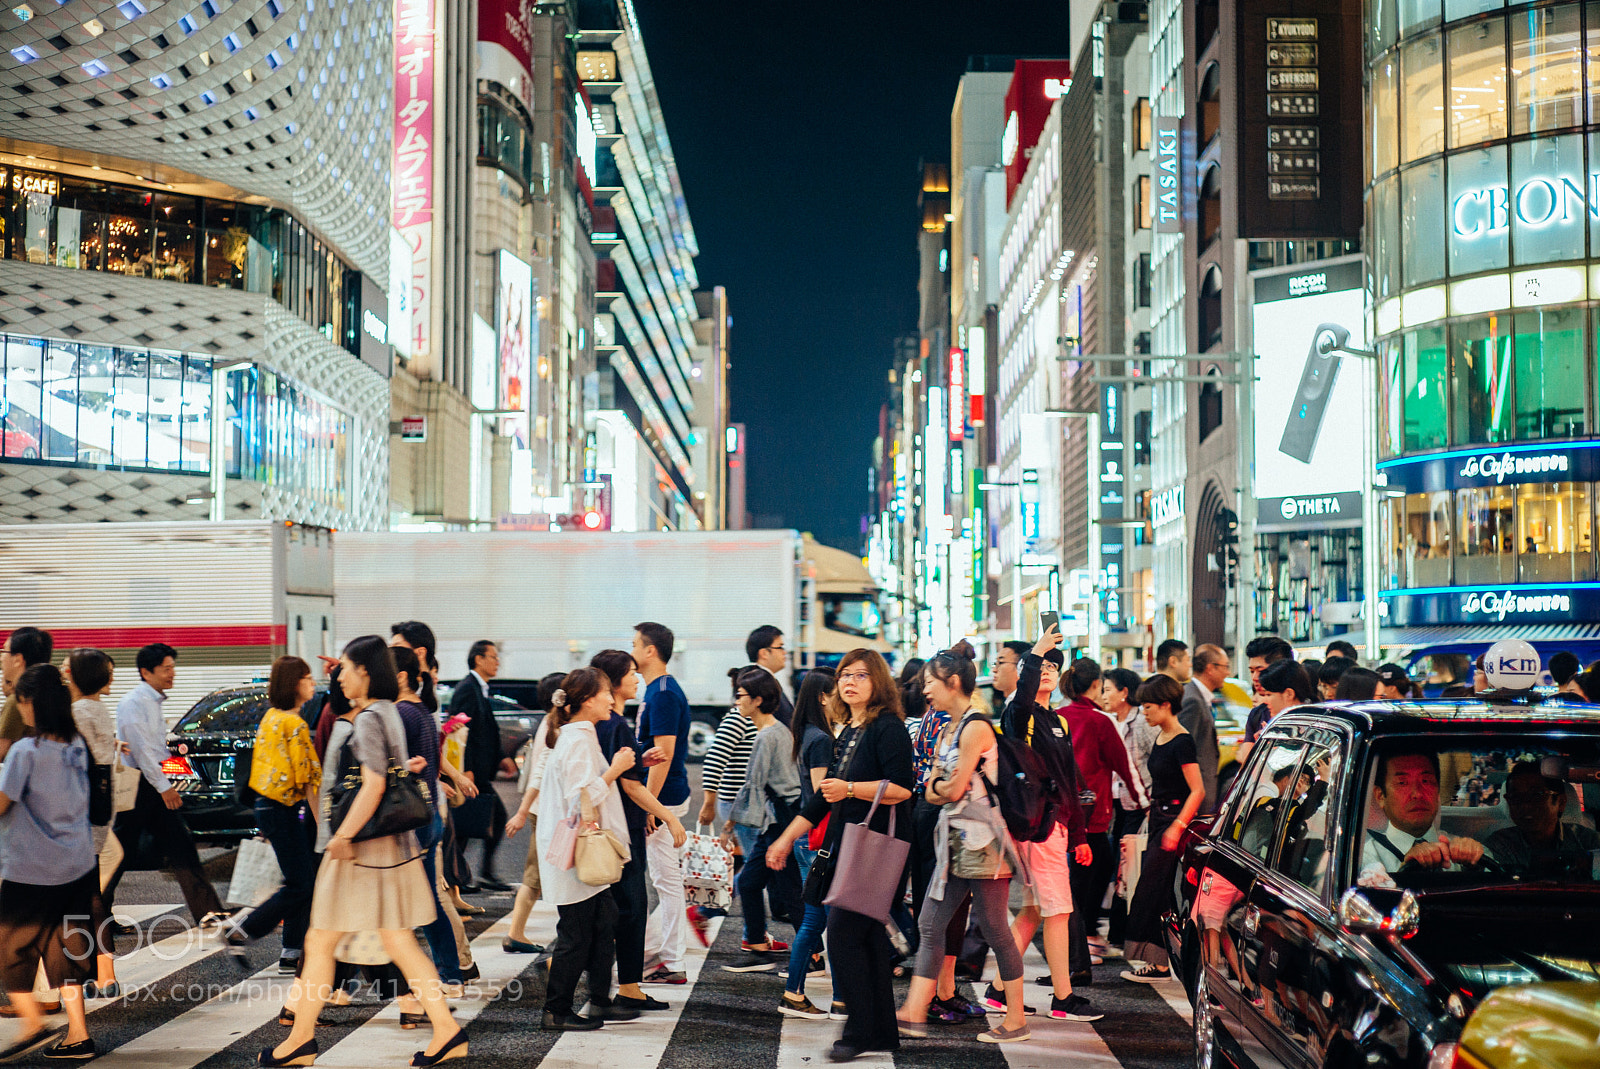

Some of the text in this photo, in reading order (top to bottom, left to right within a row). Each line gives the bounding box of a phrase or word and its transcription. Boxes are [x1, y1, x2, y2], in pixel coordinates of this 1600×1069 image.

[1270, 72, 1316, 86] 5 SVENSON
[23, 176, 57, 195] CAFE
[1159, 128, 1177, 224] TASAKI
[1289, 273, 1326, 289] RICOH
[1459, 456, 1480, 477] Le
[1480, 452, 1516, 483] Café
[1297, 497, 1341, 516] THETA
[1461, 592, 1481, 613] Le
[1481, 590, 1517, 621] Café
